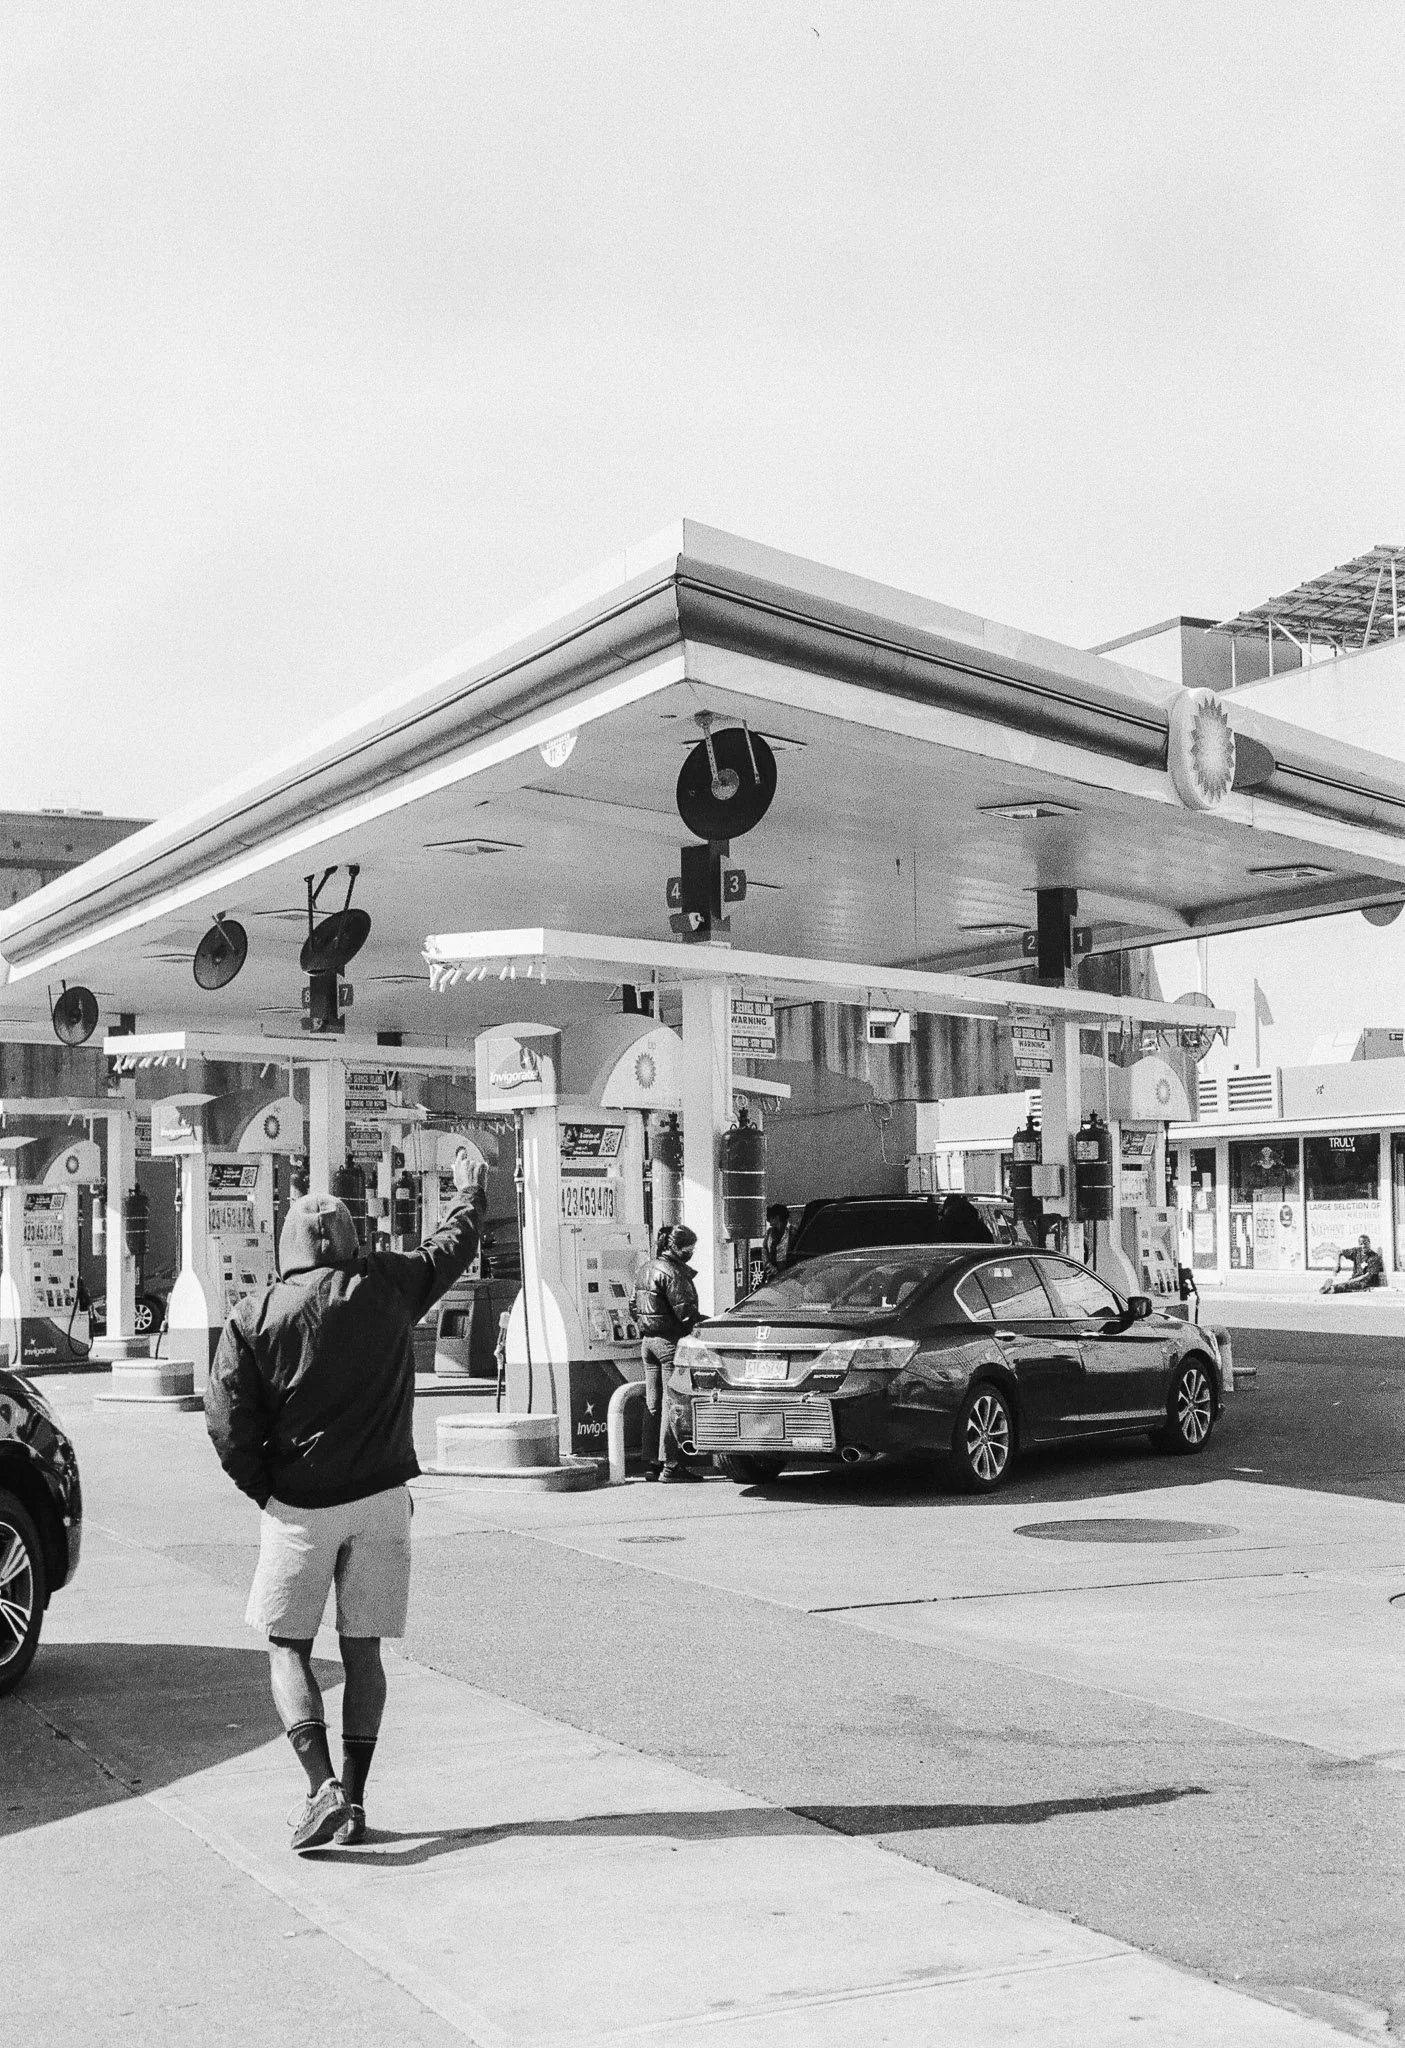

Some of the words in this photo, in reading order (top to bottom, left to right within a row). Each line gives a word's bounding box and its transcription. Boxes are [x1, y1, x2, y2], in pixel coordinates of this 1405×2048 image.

[671, 882, 681, 899] 4
[730, 875, 740, 893] 3
[1027, 935, 1036, 950] 2
[1077, 932, 1083, 947] 1
[304, 990, 311, 1003] 8
[342, 987, 349, 1001] 7
[731, 1015, 767, 1026] WARNING
[489, 1069, 540, 1085] Invigorate
[1328, 1136, 1355, 1148] TRULY
[1309, 1203, 1331, 1211] LARGE
[577, 1420, 607, 1437] Invigo
